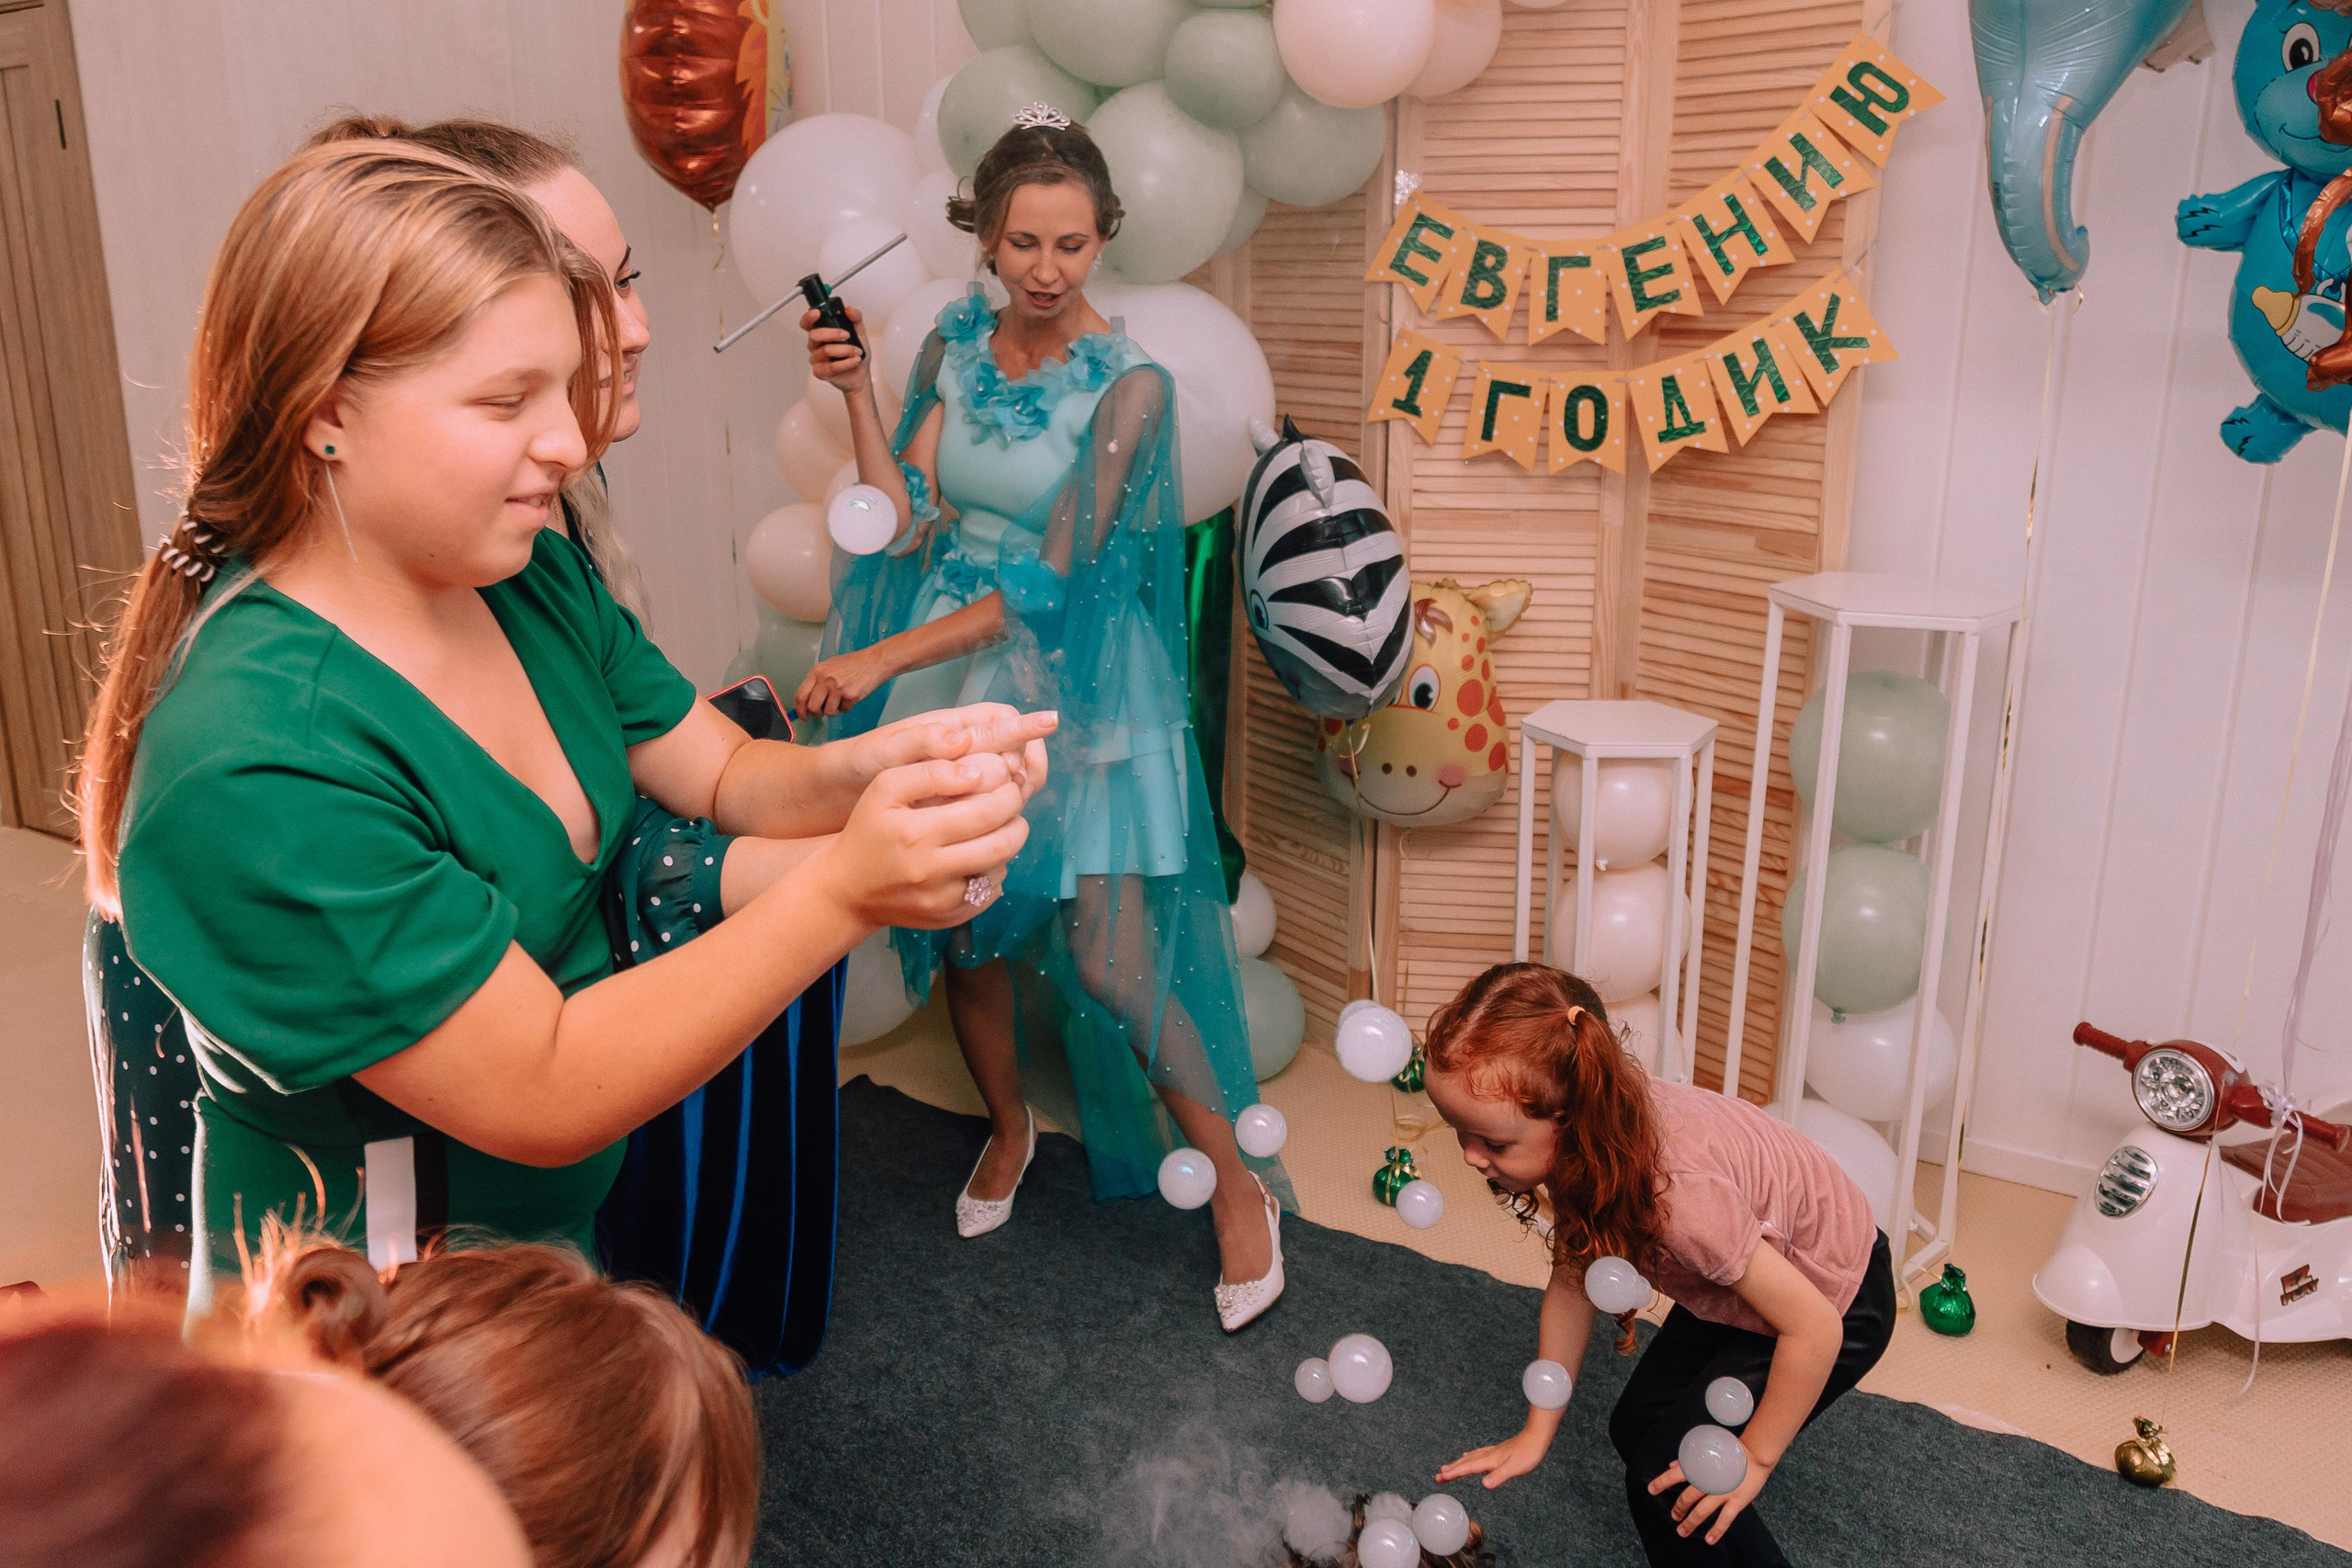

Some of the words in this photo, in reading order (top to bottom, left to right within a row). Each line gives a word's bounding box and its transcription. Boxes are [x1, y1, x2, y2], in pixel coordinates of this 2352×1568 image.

[1389, 62, 1910, 322] ЕВГЕНИЮ
[1392, 349, 1434, 418] 1
[1481, 292, 1871, 452] ГОДИК
